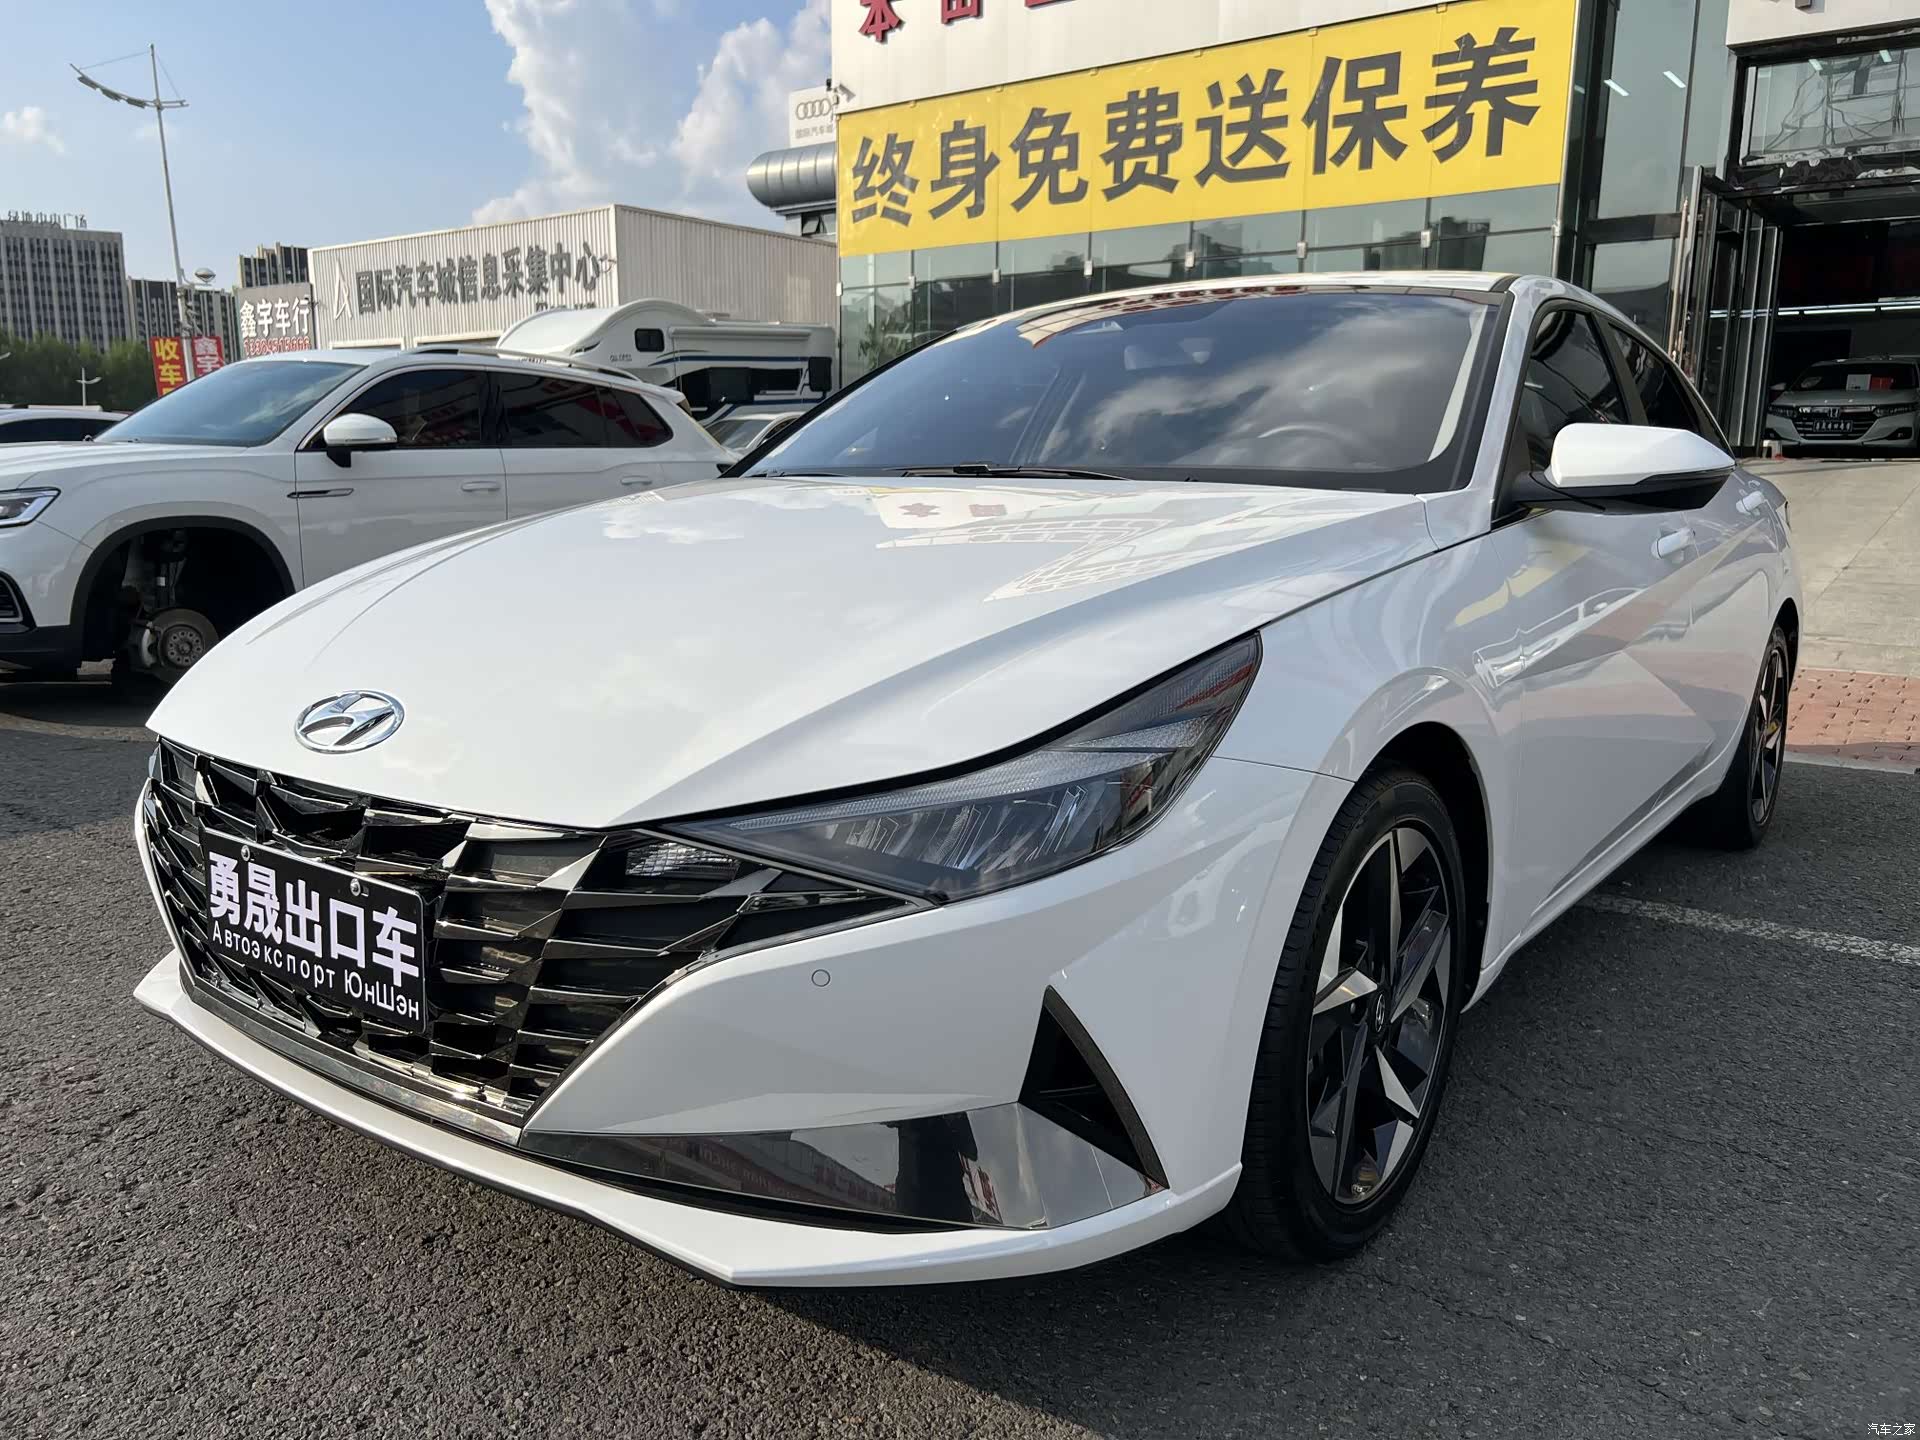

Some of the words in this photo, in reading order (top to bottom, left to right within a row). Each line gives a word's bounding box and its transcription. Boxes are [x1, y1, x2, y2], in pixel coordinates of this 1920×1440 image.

[852, 27, 1541, 227] 终身免费送保养
[355, 242, 600, 315] 国际汽车城信息采集中心
[240, 297, 310, 338] 鑫宇车行
[209, 851, 419, 987] 勇晟出口车
[344, 968, 420, 1021] ЮнШэн
